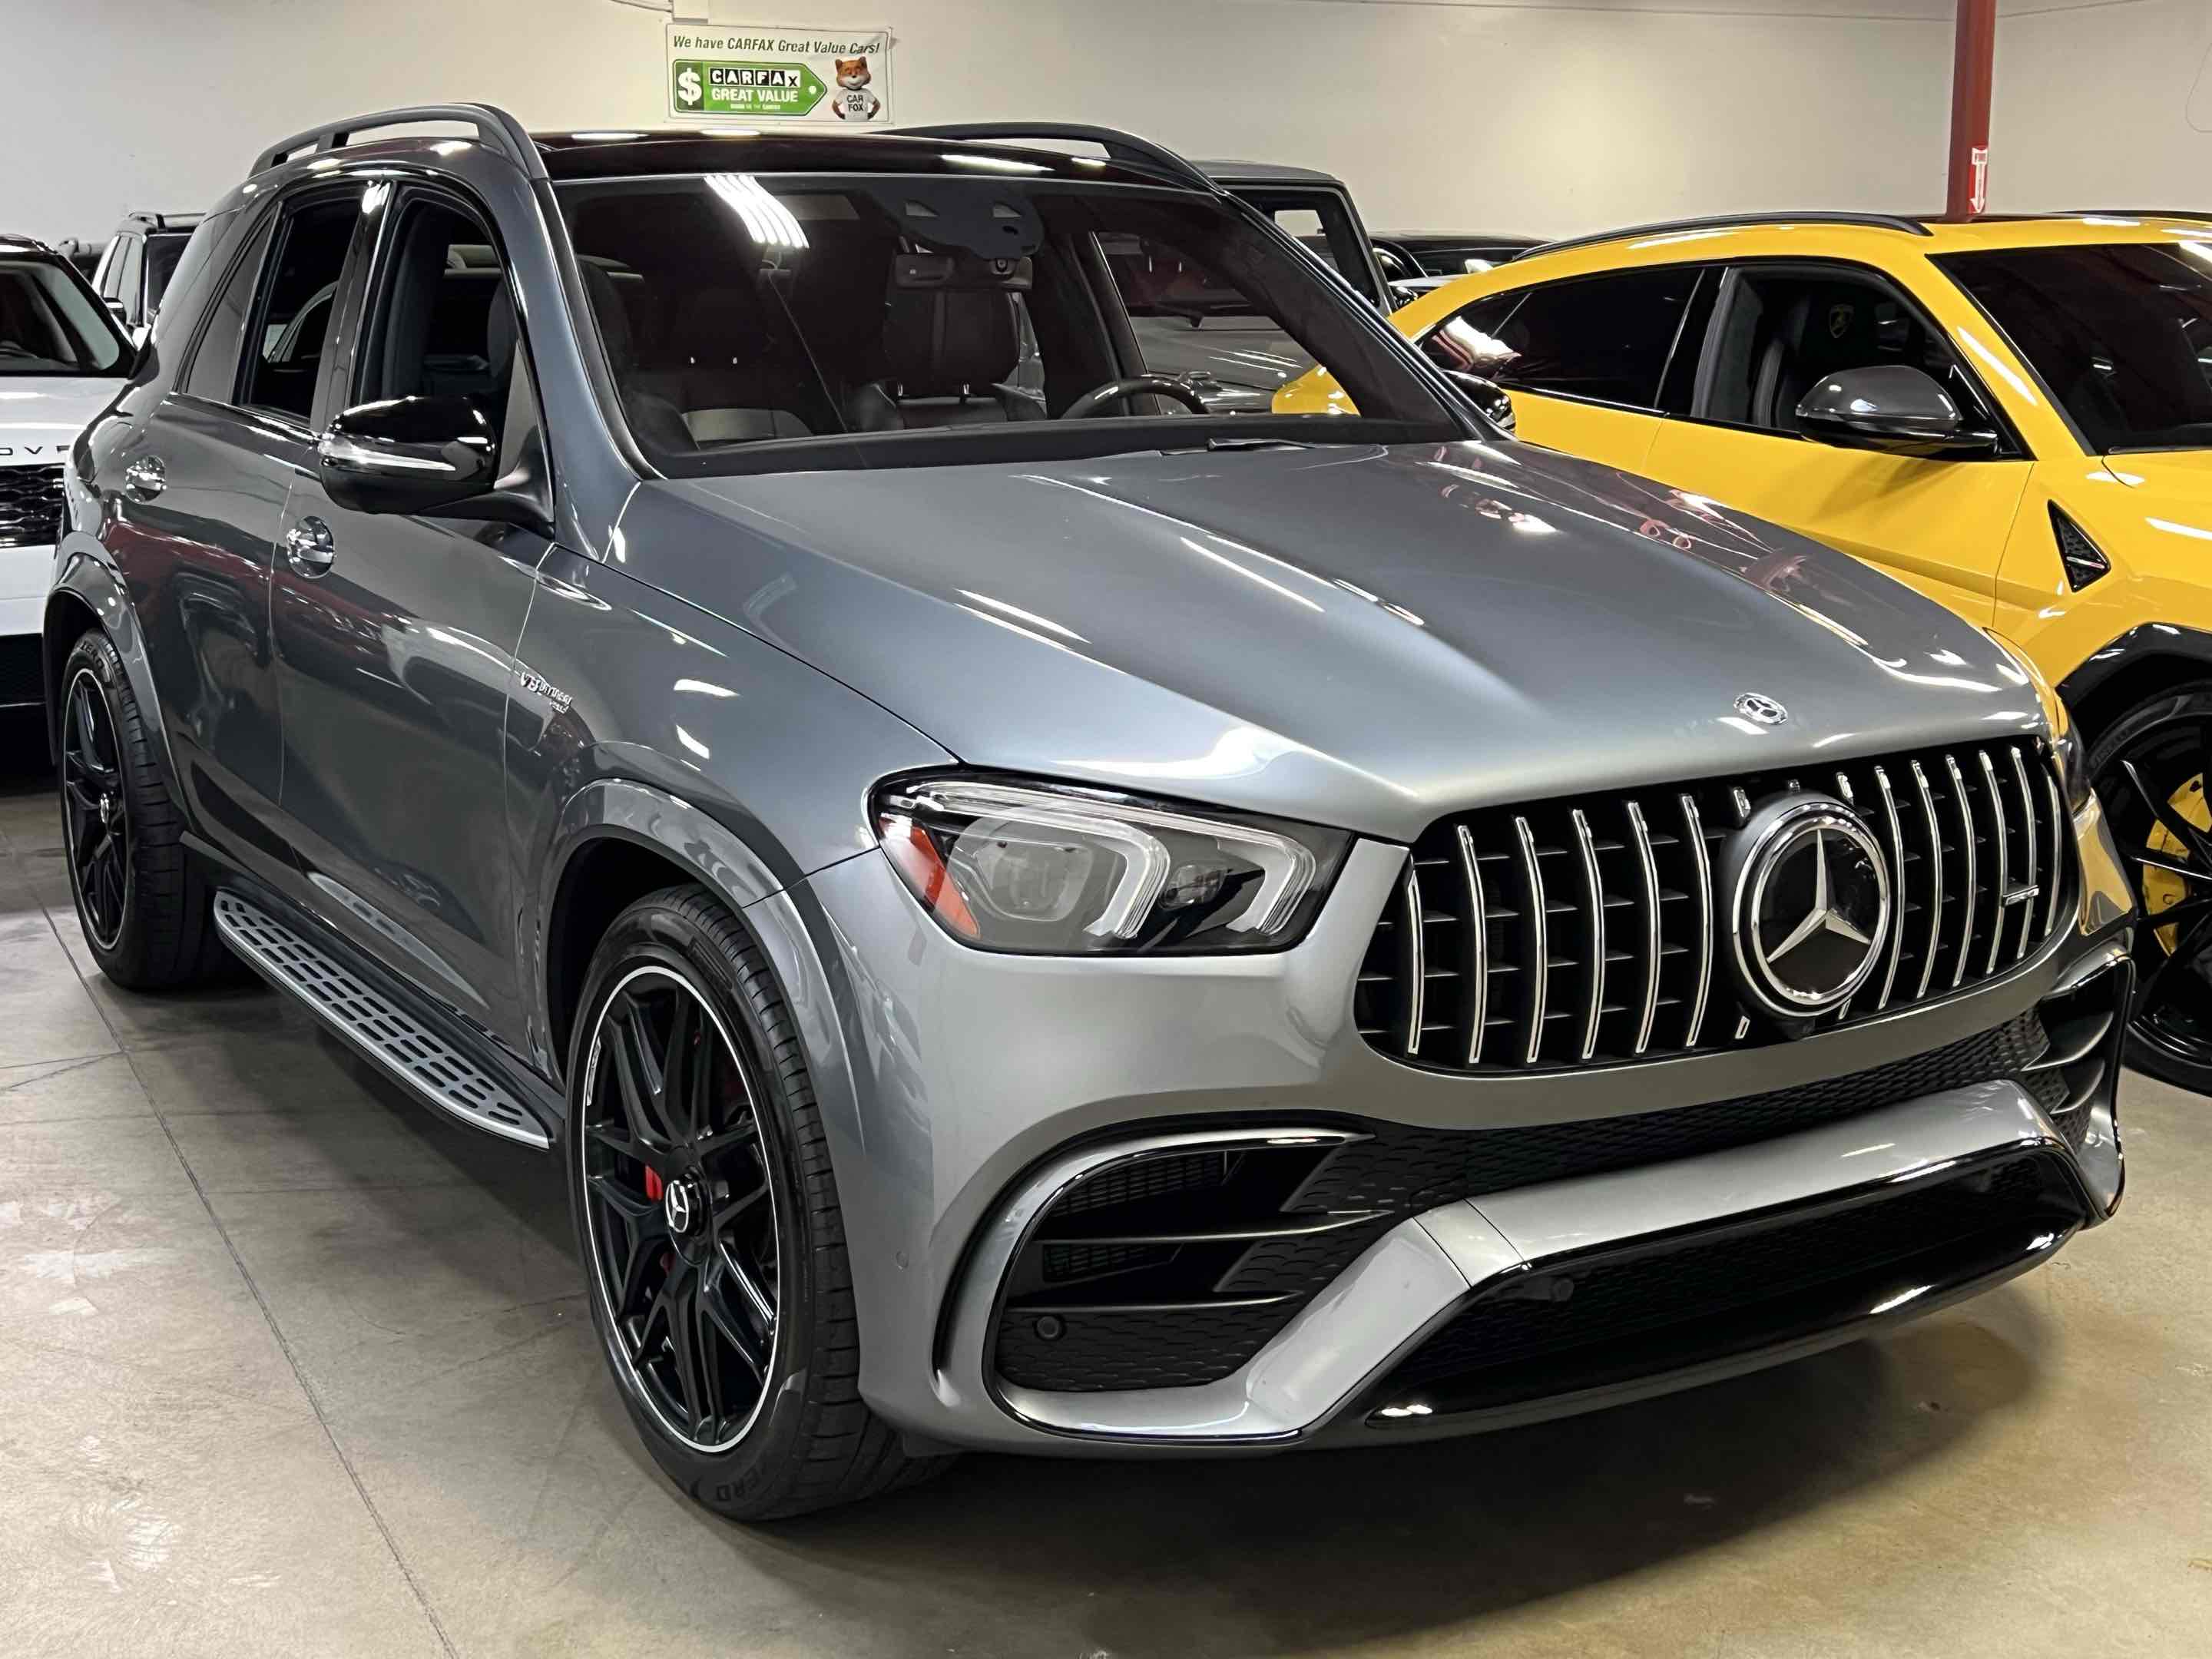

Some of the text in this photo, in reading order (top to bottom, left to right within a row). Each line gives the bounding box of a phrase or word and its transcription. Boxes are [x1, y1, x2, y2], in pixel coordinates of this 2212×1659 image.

[673, 35, 879, 54] We have CARFAX Great Value Cars!
[677, 67, 702, 106] $
[710, 69, 799, 87] CARFAX
[711, 88, 798, 102] GREAT VALUE
[847, 94, 864, 103] CAR
